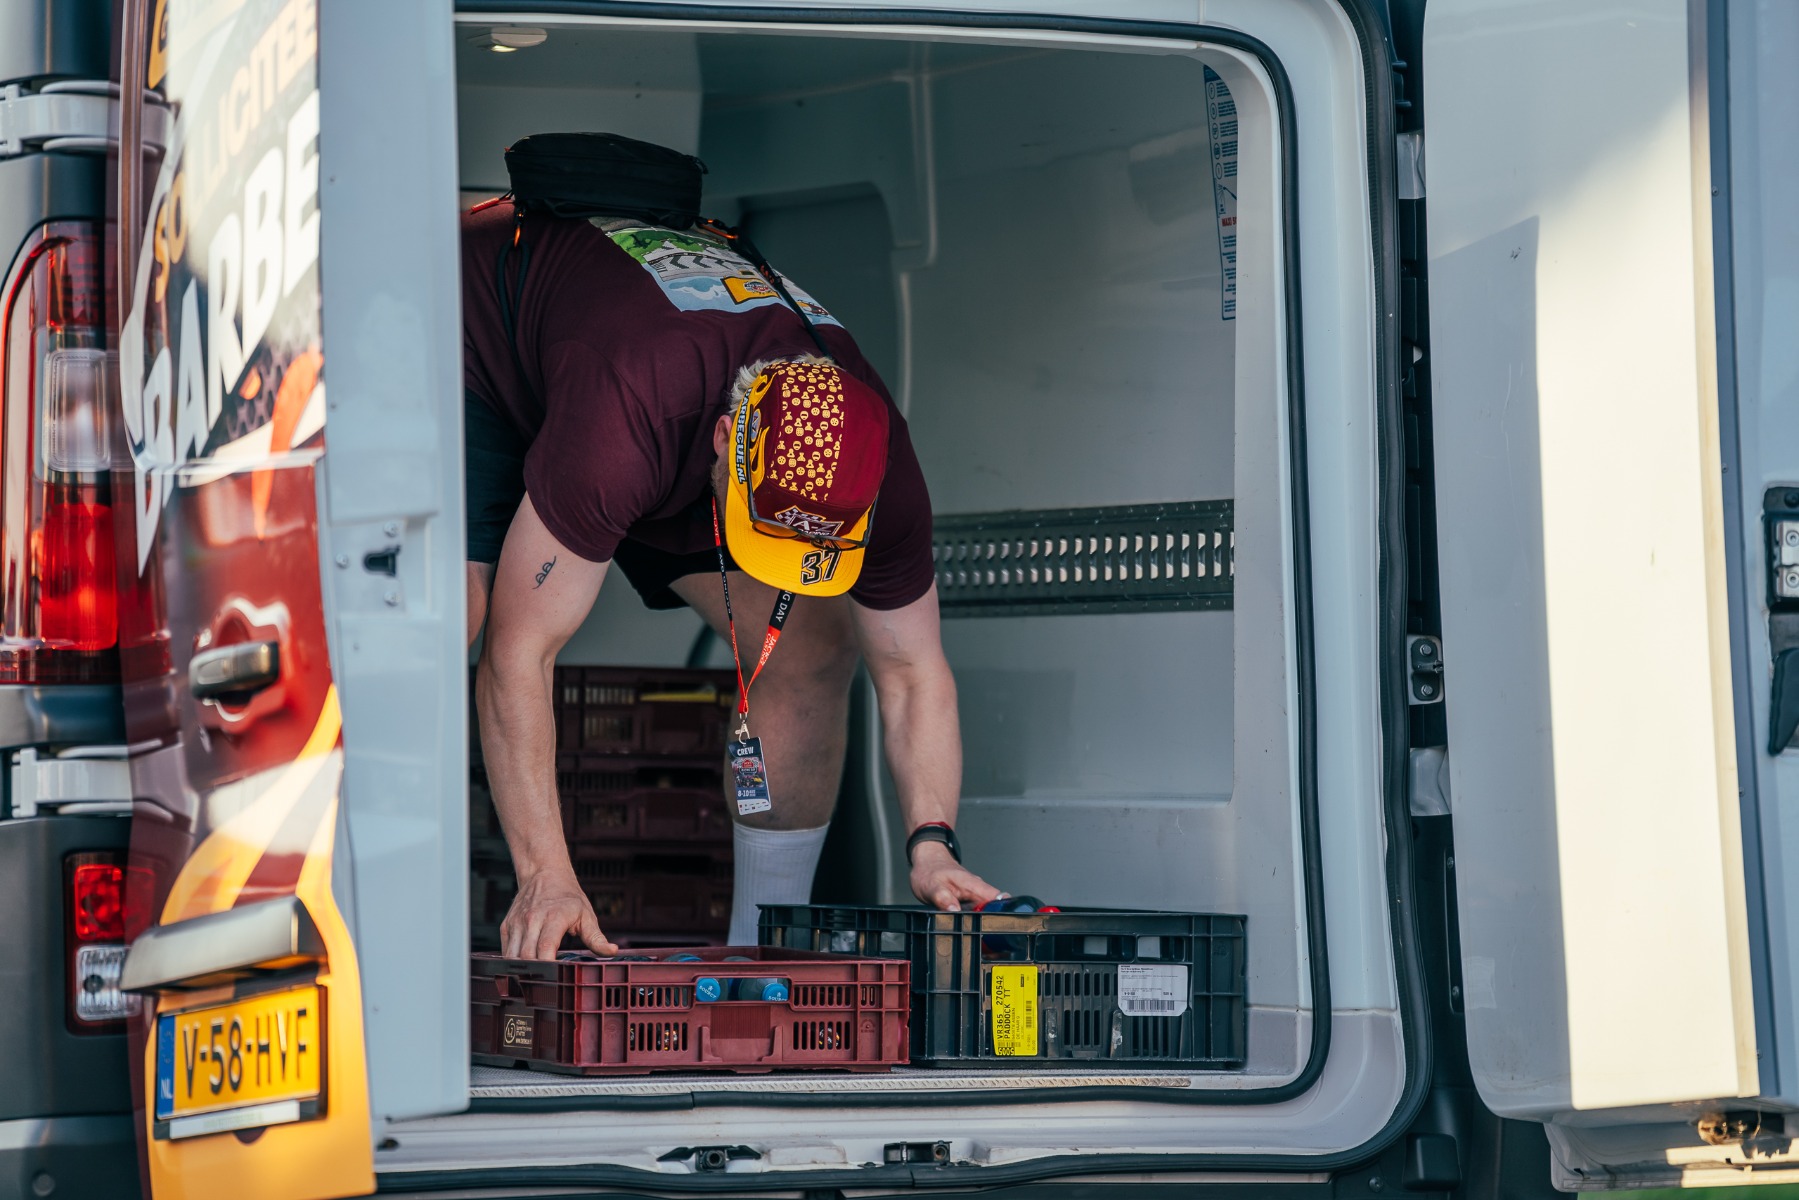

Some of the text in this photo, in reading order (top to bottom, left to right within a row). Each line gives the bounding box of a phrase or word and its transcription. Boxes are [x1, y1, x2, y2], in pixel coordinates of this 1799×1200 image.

[793, 520, 836, 533] A-Z
[801, 549, 842, 585] 37
[775, 603, 788, 623] DAY
[737, 746, 754, 756] CREW
[996, 975, 1004, 1006] 270542
[1004, 988, 1011, 998] TT
[183, 1008, 307, 1099] V-58-HVF
[161, 1078, 173, 1100] NL
